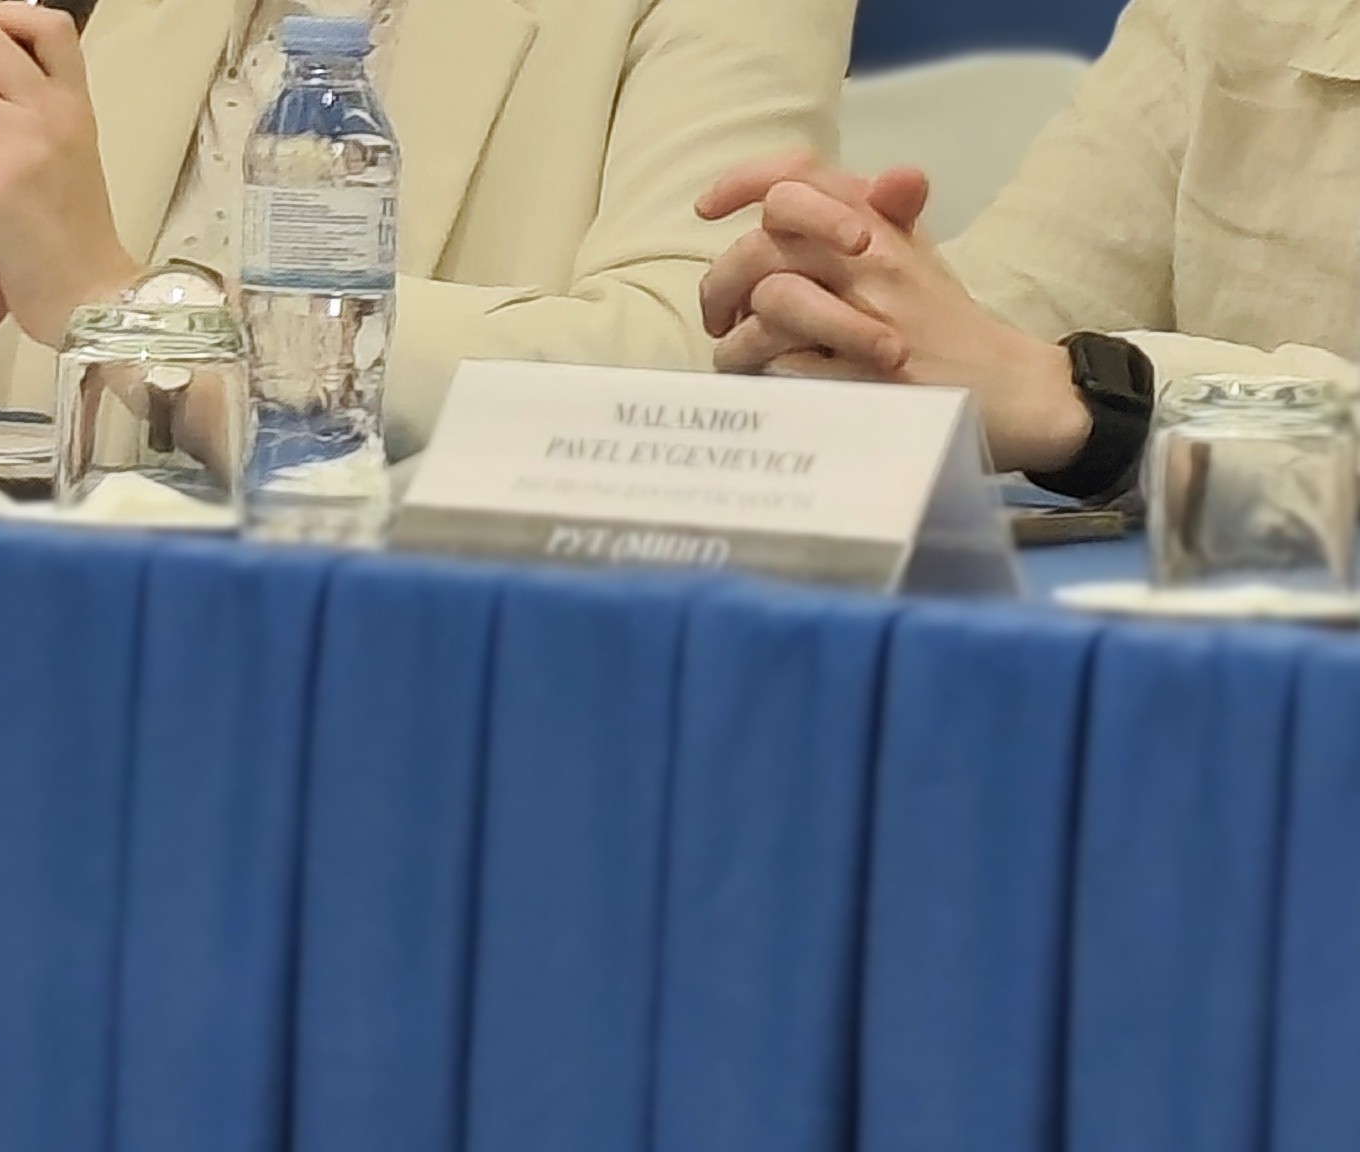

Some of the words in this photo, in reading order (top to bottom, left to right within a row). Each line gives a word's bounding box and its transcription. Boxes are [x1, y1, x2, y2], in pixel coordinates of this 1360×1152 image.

[614, 402, 768, 432] MALAKHOV
[546, 435, 626, 463] PAVEL
[628, 440, 817, 475] EVGENIEVICH
